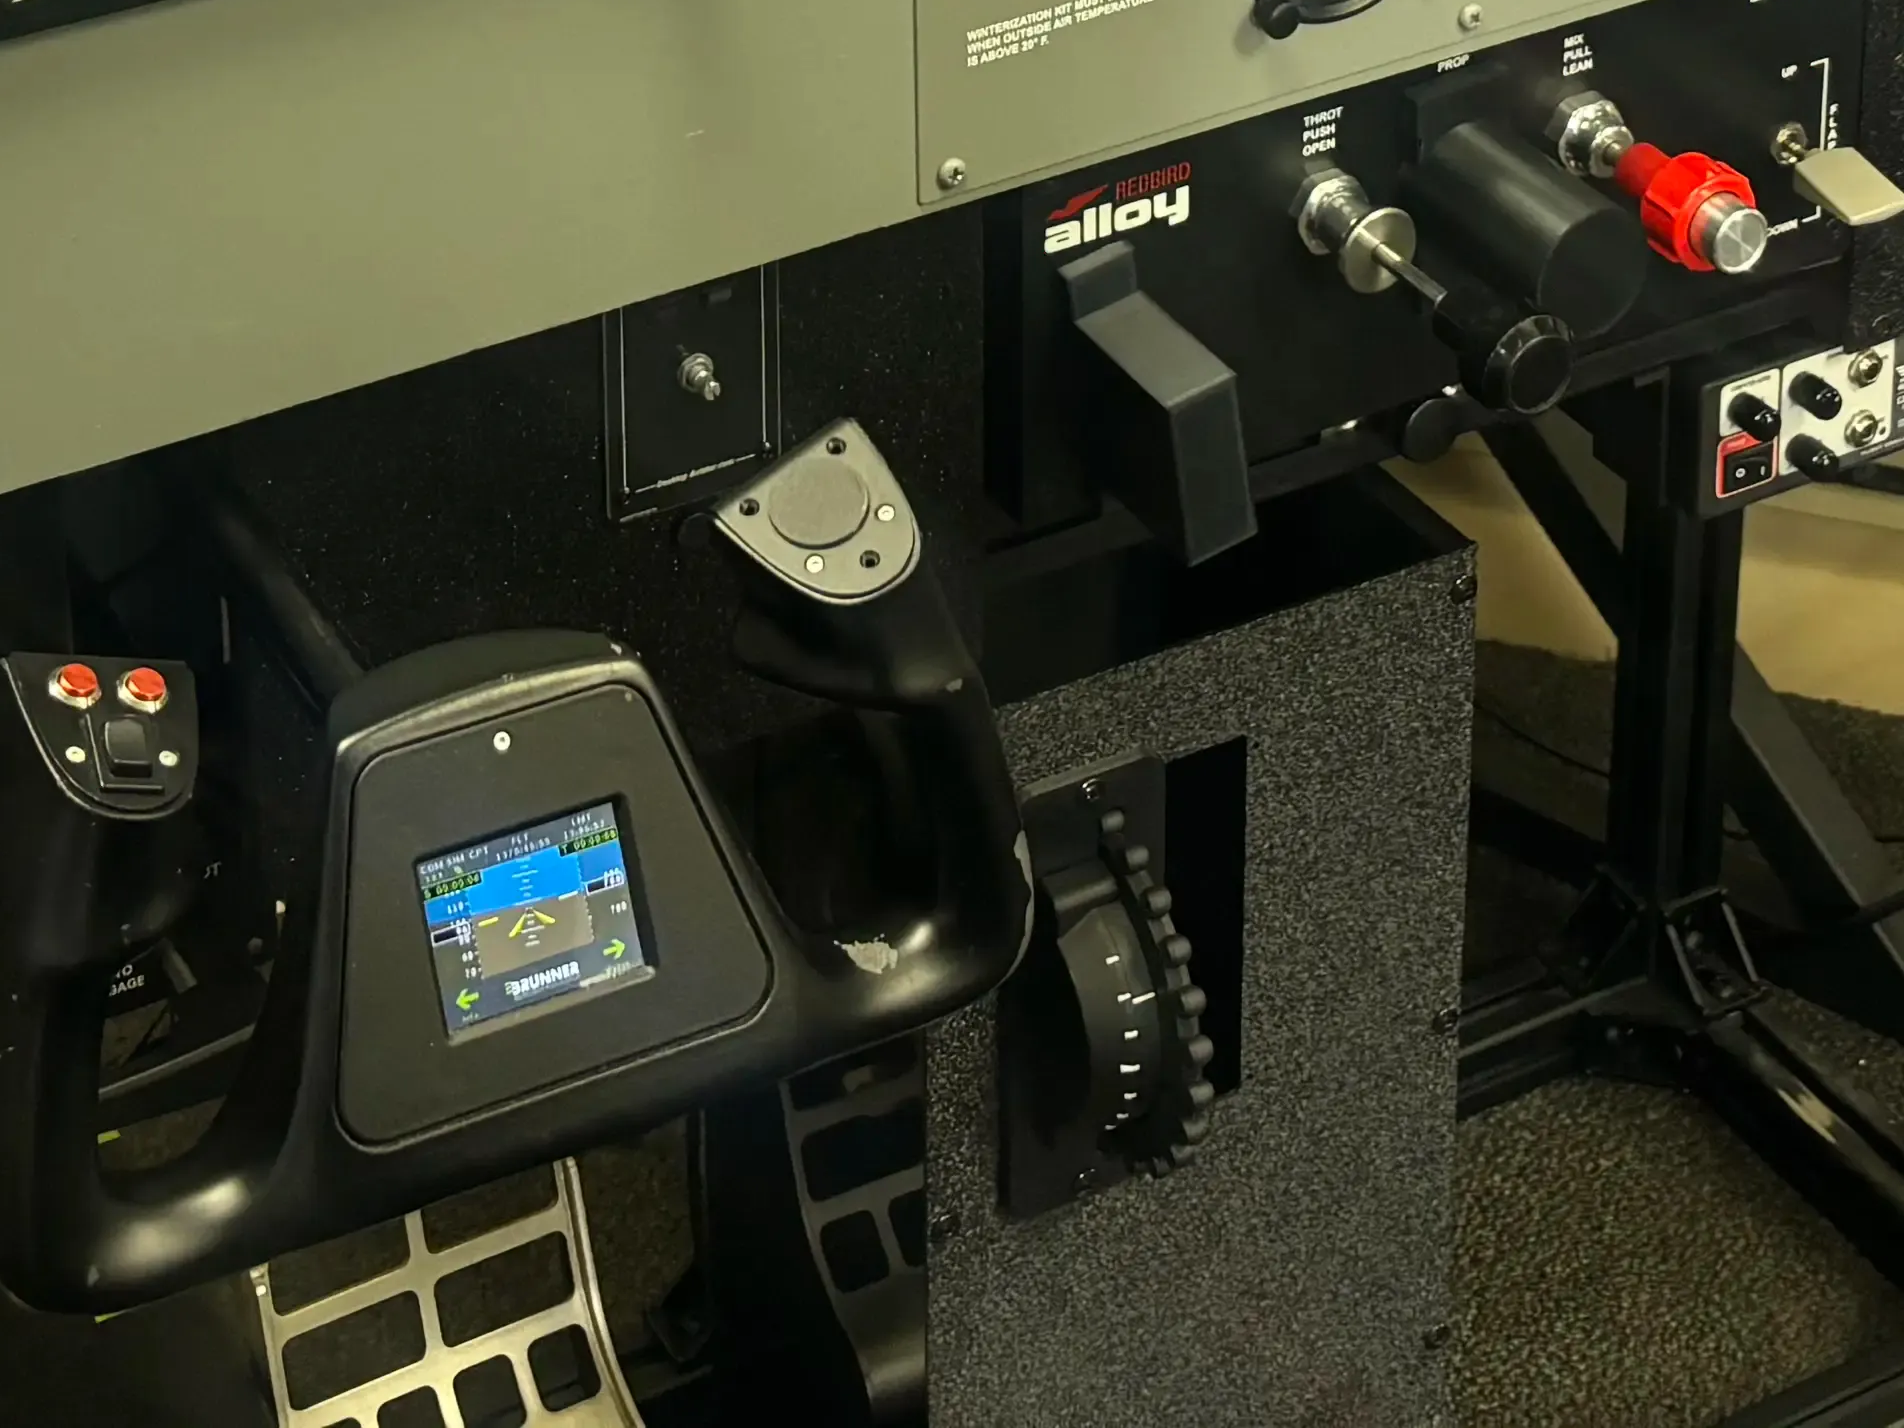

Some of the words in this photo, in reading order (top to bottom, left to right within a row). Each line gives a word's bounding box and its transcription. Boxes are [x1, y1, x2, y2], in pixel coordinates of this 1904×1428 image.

[1564, 33, 1584, 48] MIX
[1437, 54, 1469, 73] PROP
[1564, 46, 1592, 63] PULL
[1563, 59, 1593, 77] LEAN
[1782, 64, 1797, 78] UP
[1304, 106, 1343, 128] THROT
[1303, 123, 1335, 143] PUSH
[1302, 137, 1335, 157] OPEN
[1116, 161, 1191, 201] REDBIRD
[1044, 185, 1190, 254] alloy
[511, 960, 580, 996] BRUNNER
